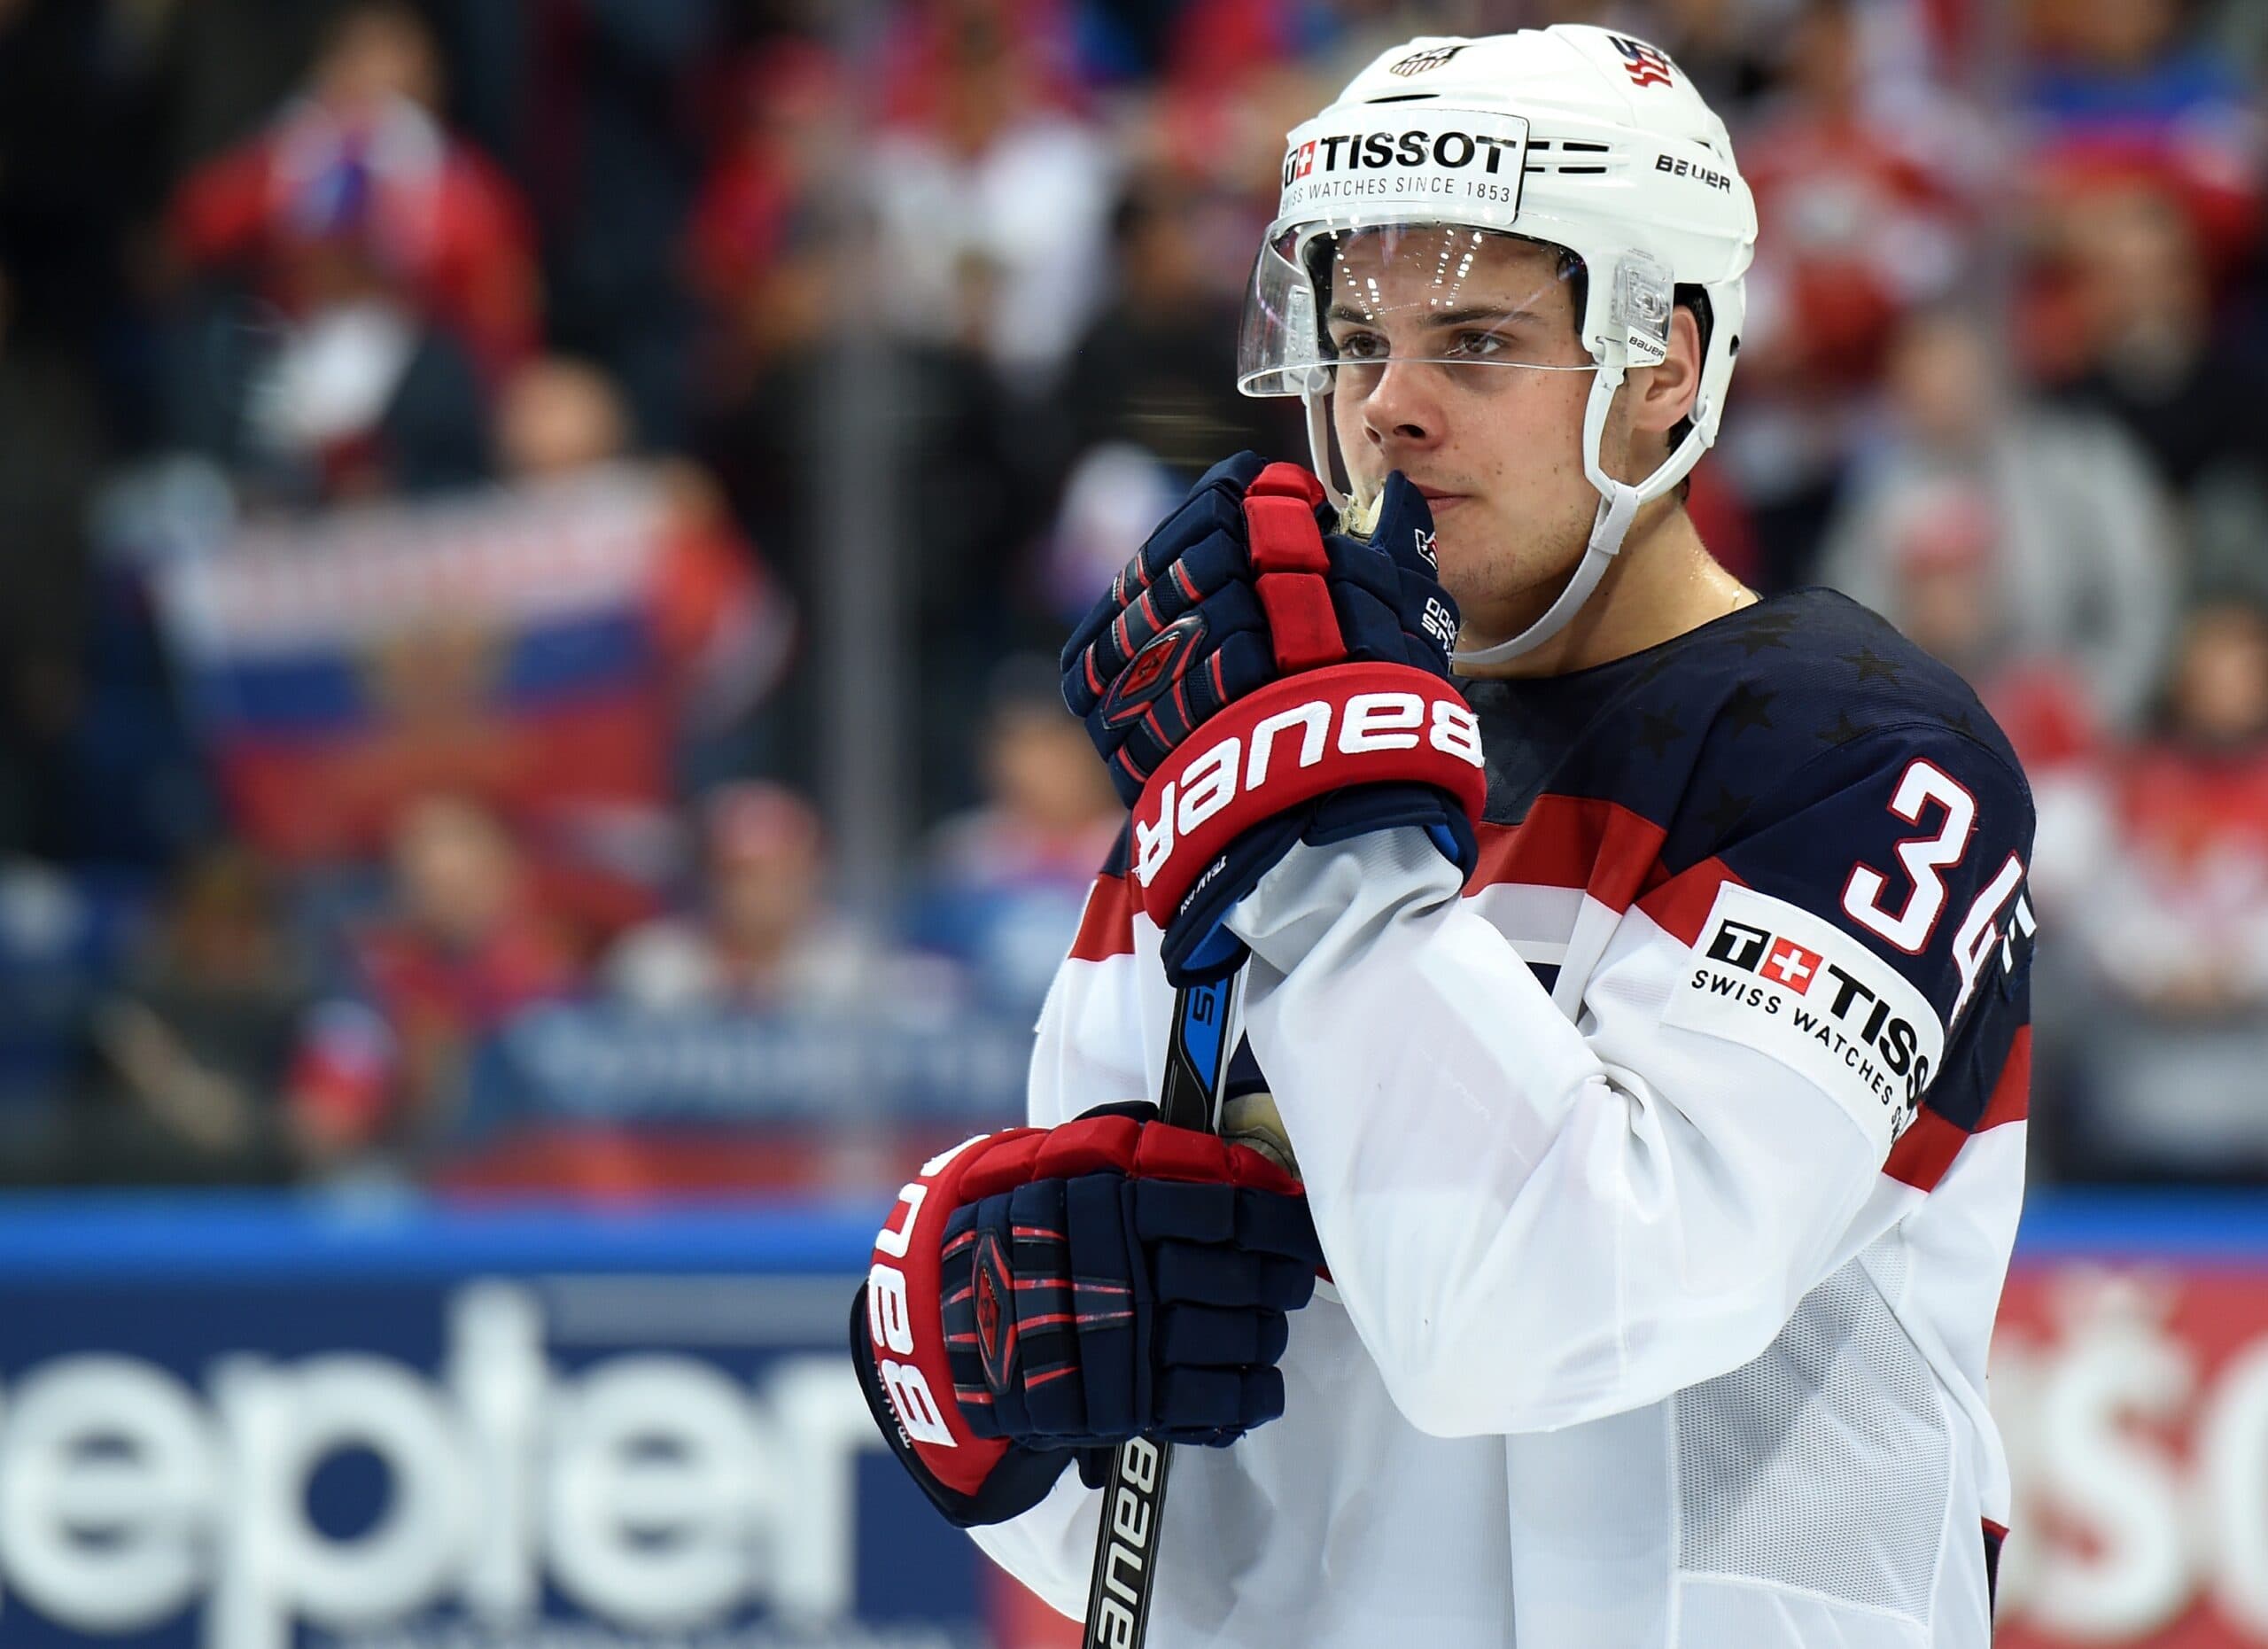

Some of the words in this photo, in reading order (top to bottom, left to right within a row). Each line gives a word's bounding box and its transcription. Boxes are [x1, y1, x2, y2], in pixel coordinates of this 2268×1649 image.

[1309, 177, 1387, 200] WATCHES
[1395, 176, 1455, 194] SINCE
[1466, 182, 1511, 203] 1853
[1320, 130, 1517, 175] TISSOT
[1691, 969, 1782, 1014] SWISS
[1792, 1007, 1893, 1106] WATCHES
[1827, 963, 1930, 1112] TISS
